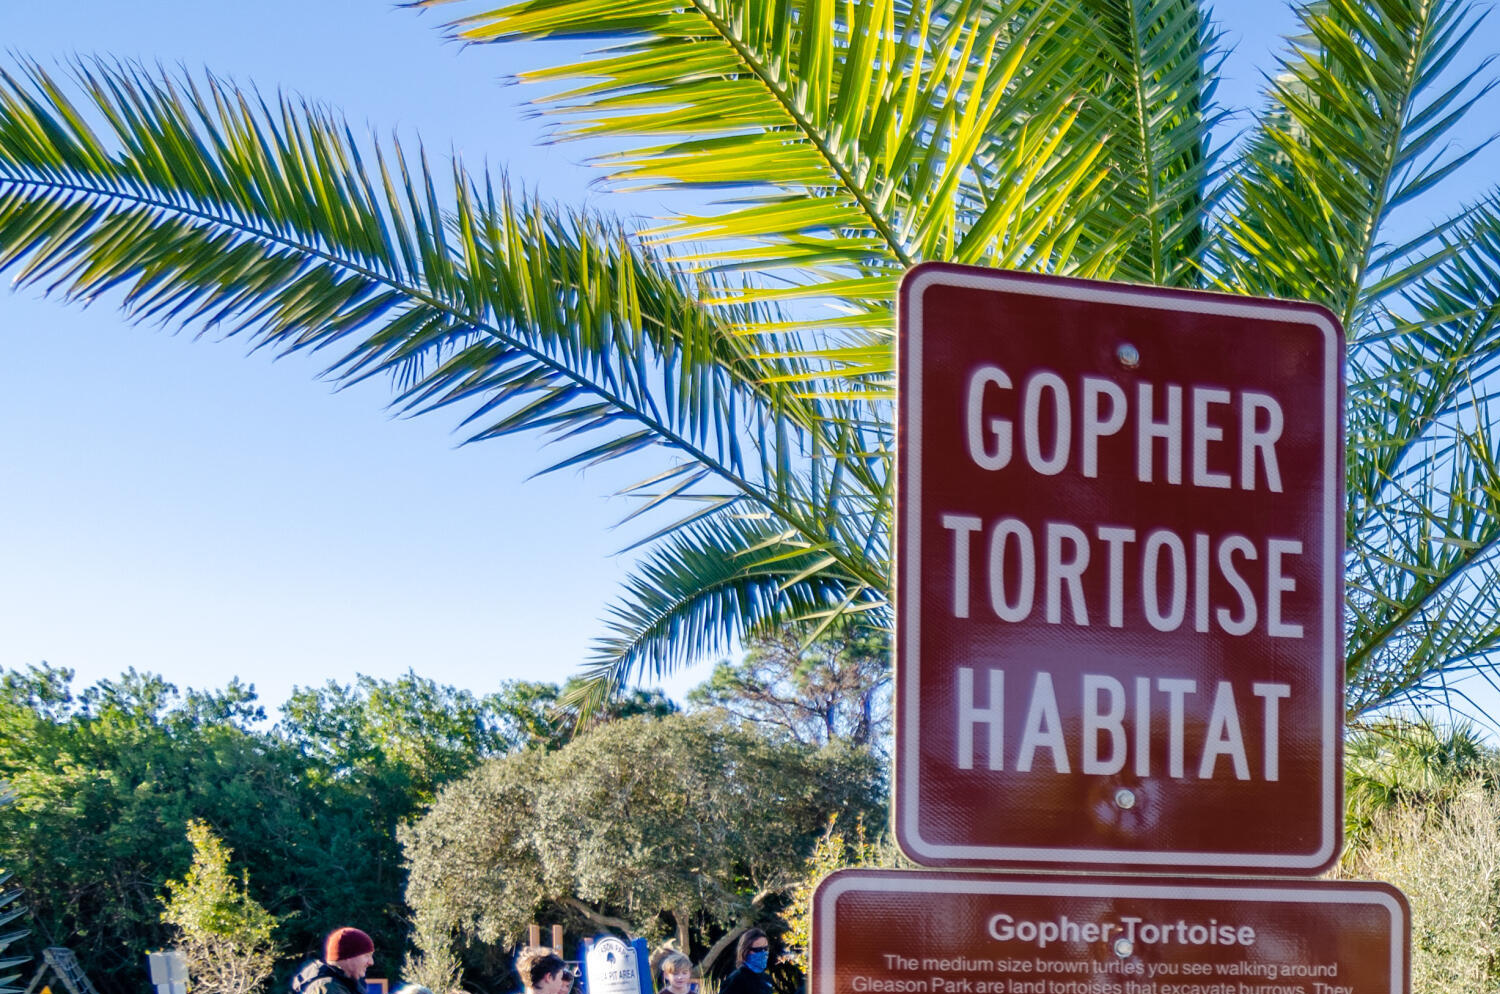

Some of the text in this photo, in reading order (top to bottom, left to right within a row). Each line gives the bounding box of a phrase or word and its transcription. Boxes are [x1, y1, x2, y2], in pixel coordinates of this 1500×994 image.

[966, 366, 1285, 494] GOPHER
[941, 515, 1304, 639] TORTOISE
[957, 667, 1291, 782] HABITAT
[852, 976, 927, 993] Gleason
[932, 978, 971, 993] Park
[977, 983, 1004, 994] are
[1008, 979, 1044, 994] land
[988, 914, 1256, 948] Gopher Tortoise
